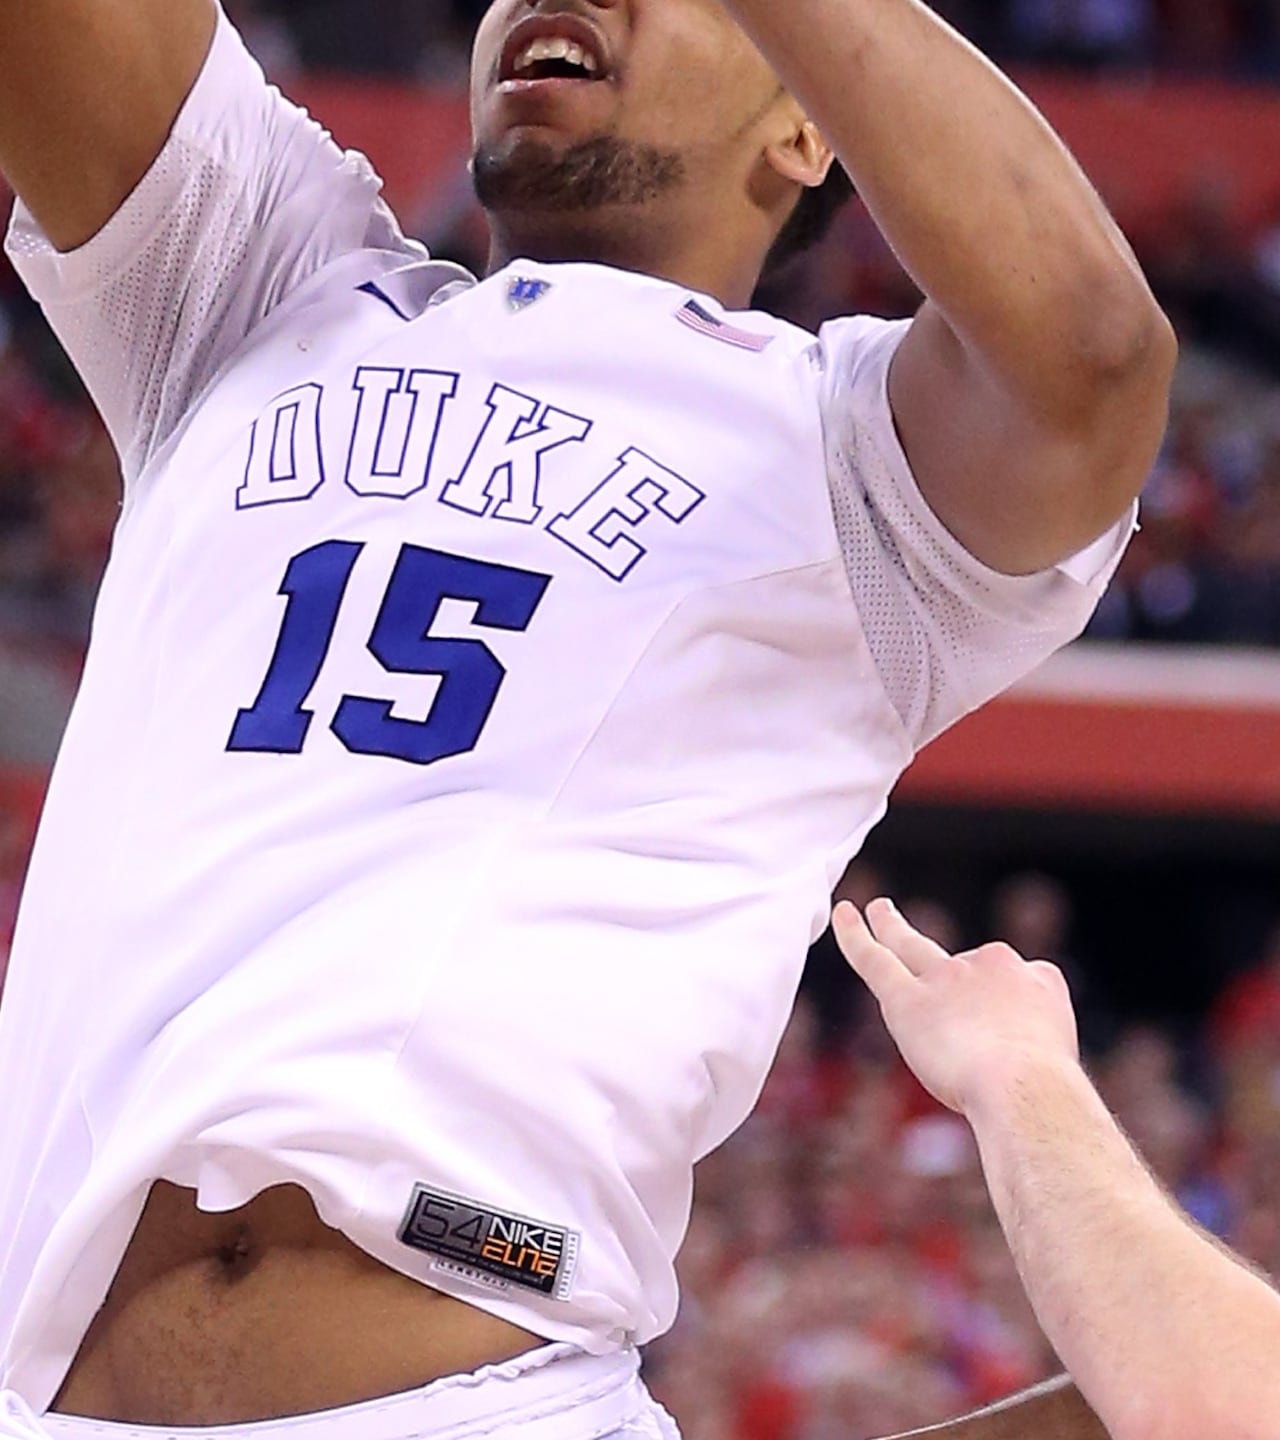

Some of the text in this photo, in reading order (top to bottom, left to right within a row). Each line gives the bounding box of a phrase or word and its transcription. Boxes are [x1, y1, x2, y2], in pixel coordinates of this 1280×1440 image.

[235, 364, 707, 583] DUKE
[225, 538, 554, 767] 15
[489, 1216, 563, 1256] NIKE
